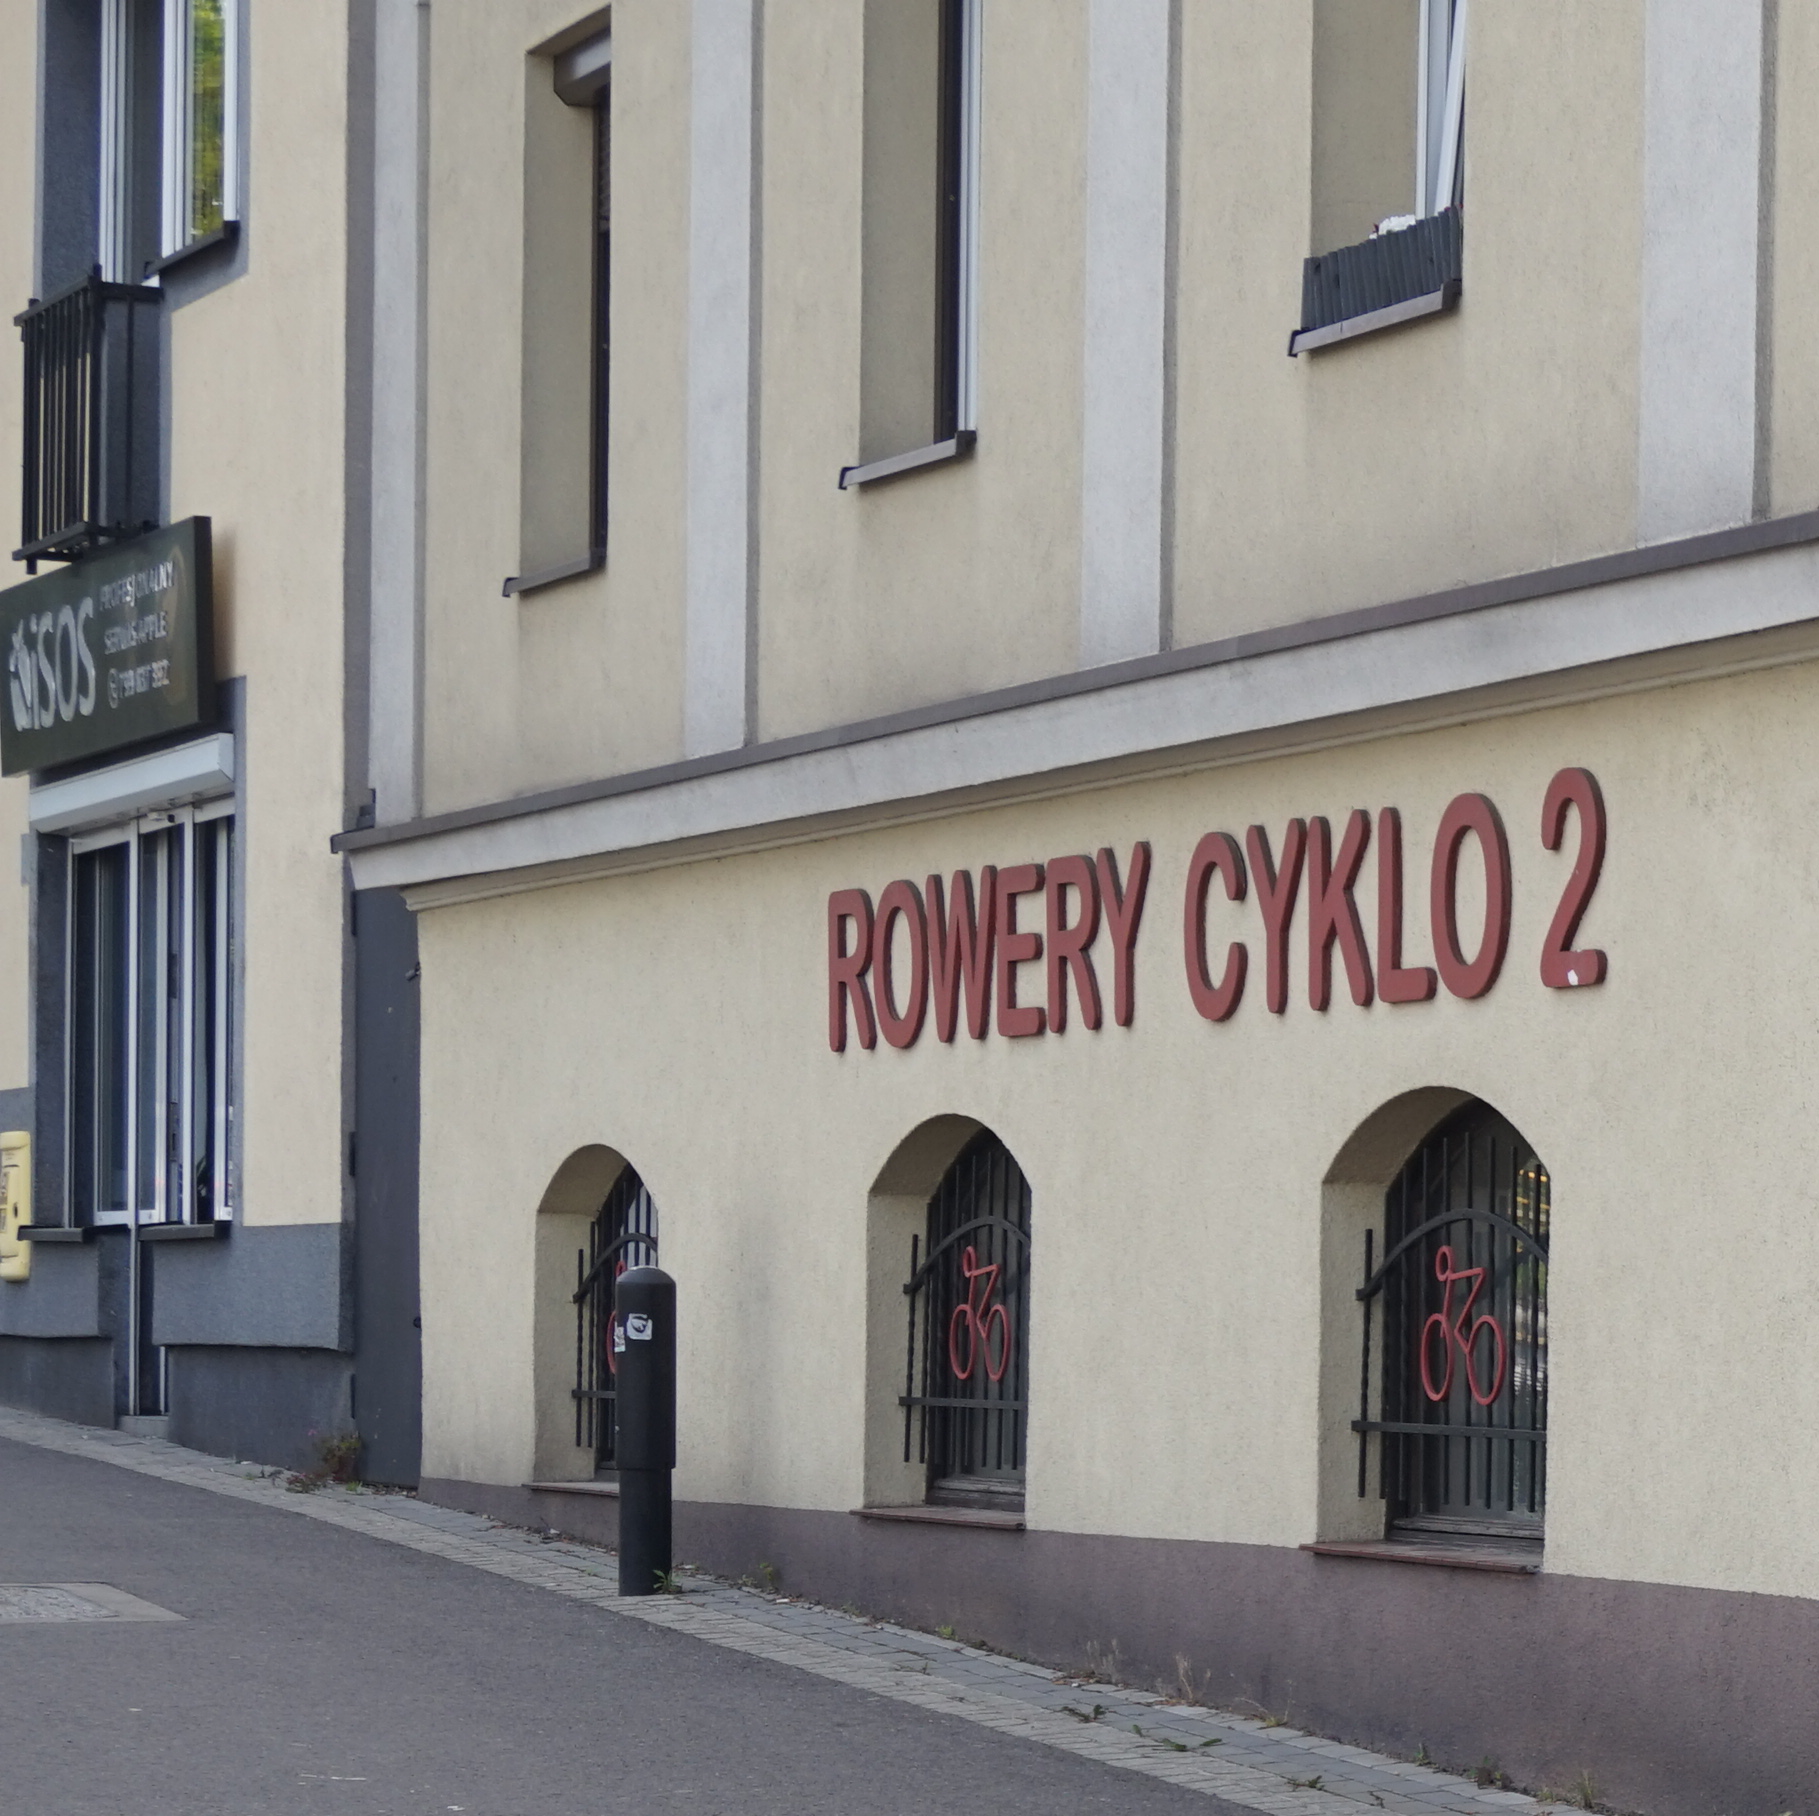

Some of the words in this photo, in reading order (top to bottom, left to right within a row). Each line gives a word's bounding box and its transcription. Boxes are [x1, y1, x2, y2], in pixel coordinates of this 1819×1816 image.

[827, 840, 1152, 1053] ROWERY
[1183, 792, 1513, 1023] CYKLO
[1539, 766, 1609, 989] 2
